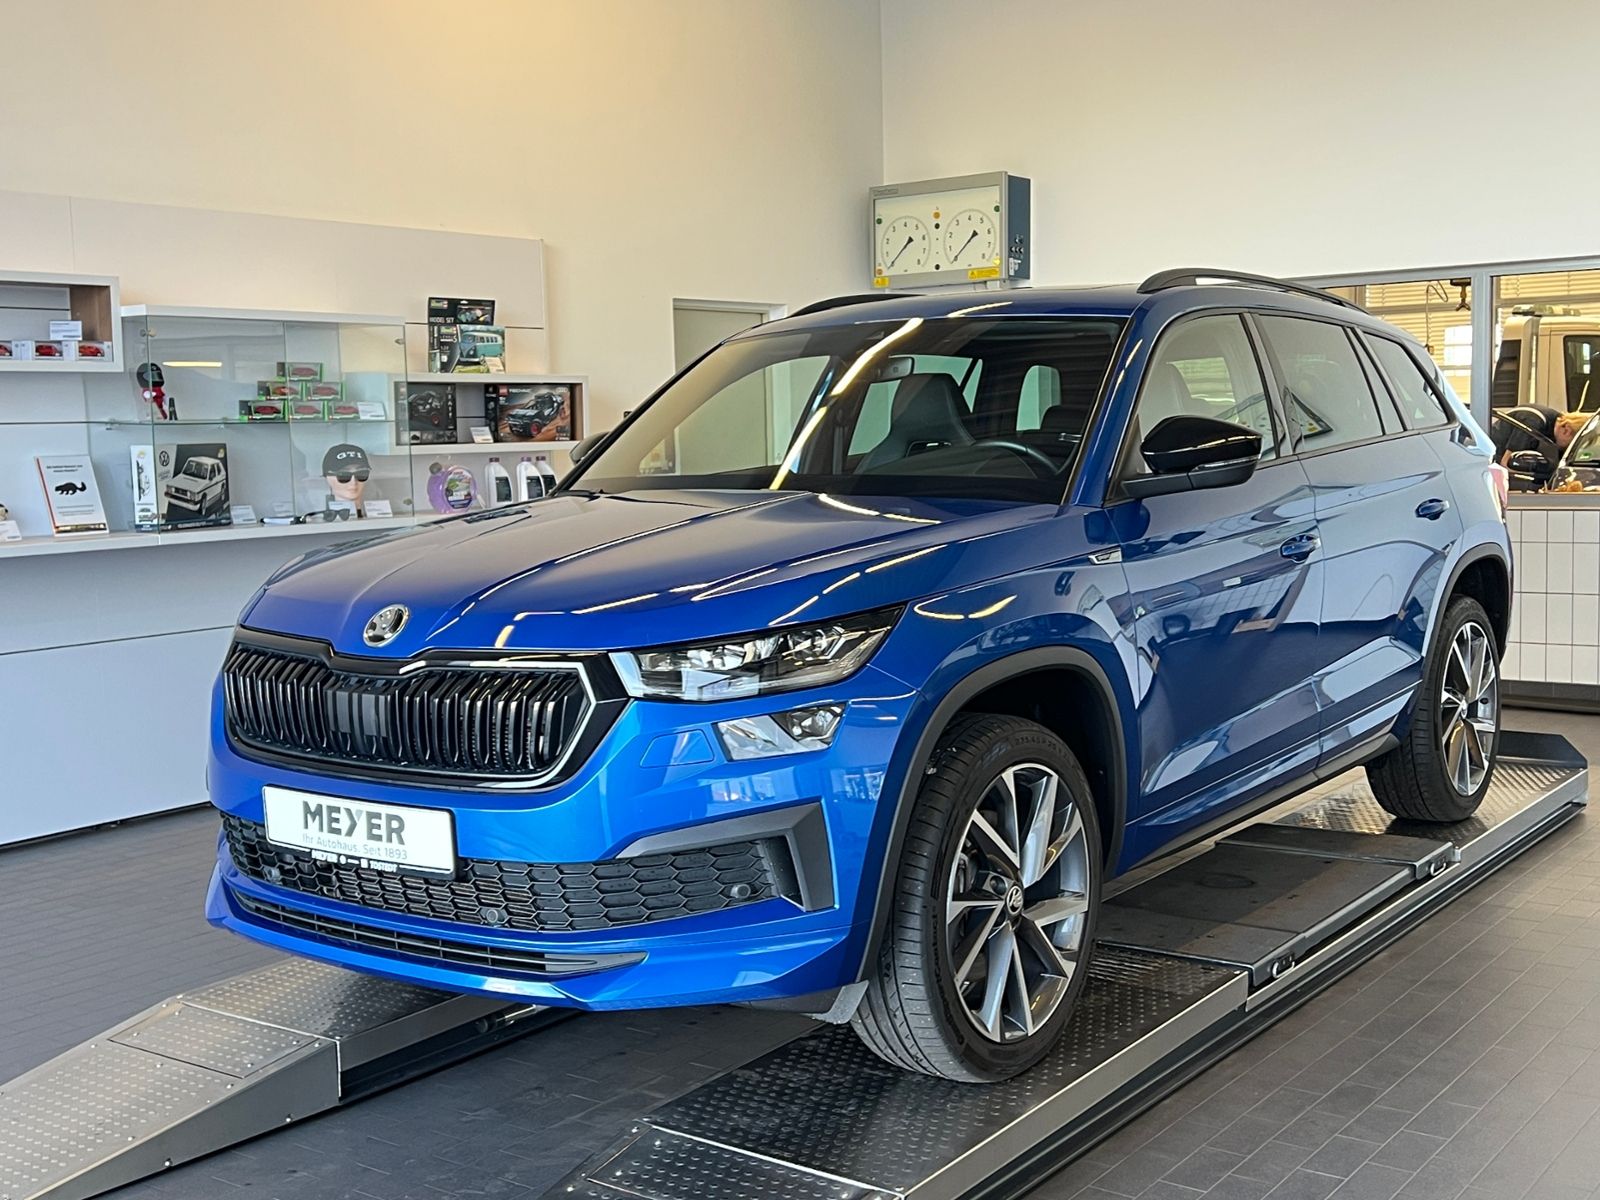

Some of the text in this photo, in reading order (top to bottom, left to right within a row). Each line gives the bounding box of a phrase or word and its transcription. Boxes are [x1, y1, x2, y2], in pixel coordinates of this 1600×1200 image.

[336, 451, 362, 460] GTI
[302, 800, 406, 846] MEYER
[302, 833, 408, 860] Ihr Autohaus. Seit 1893
